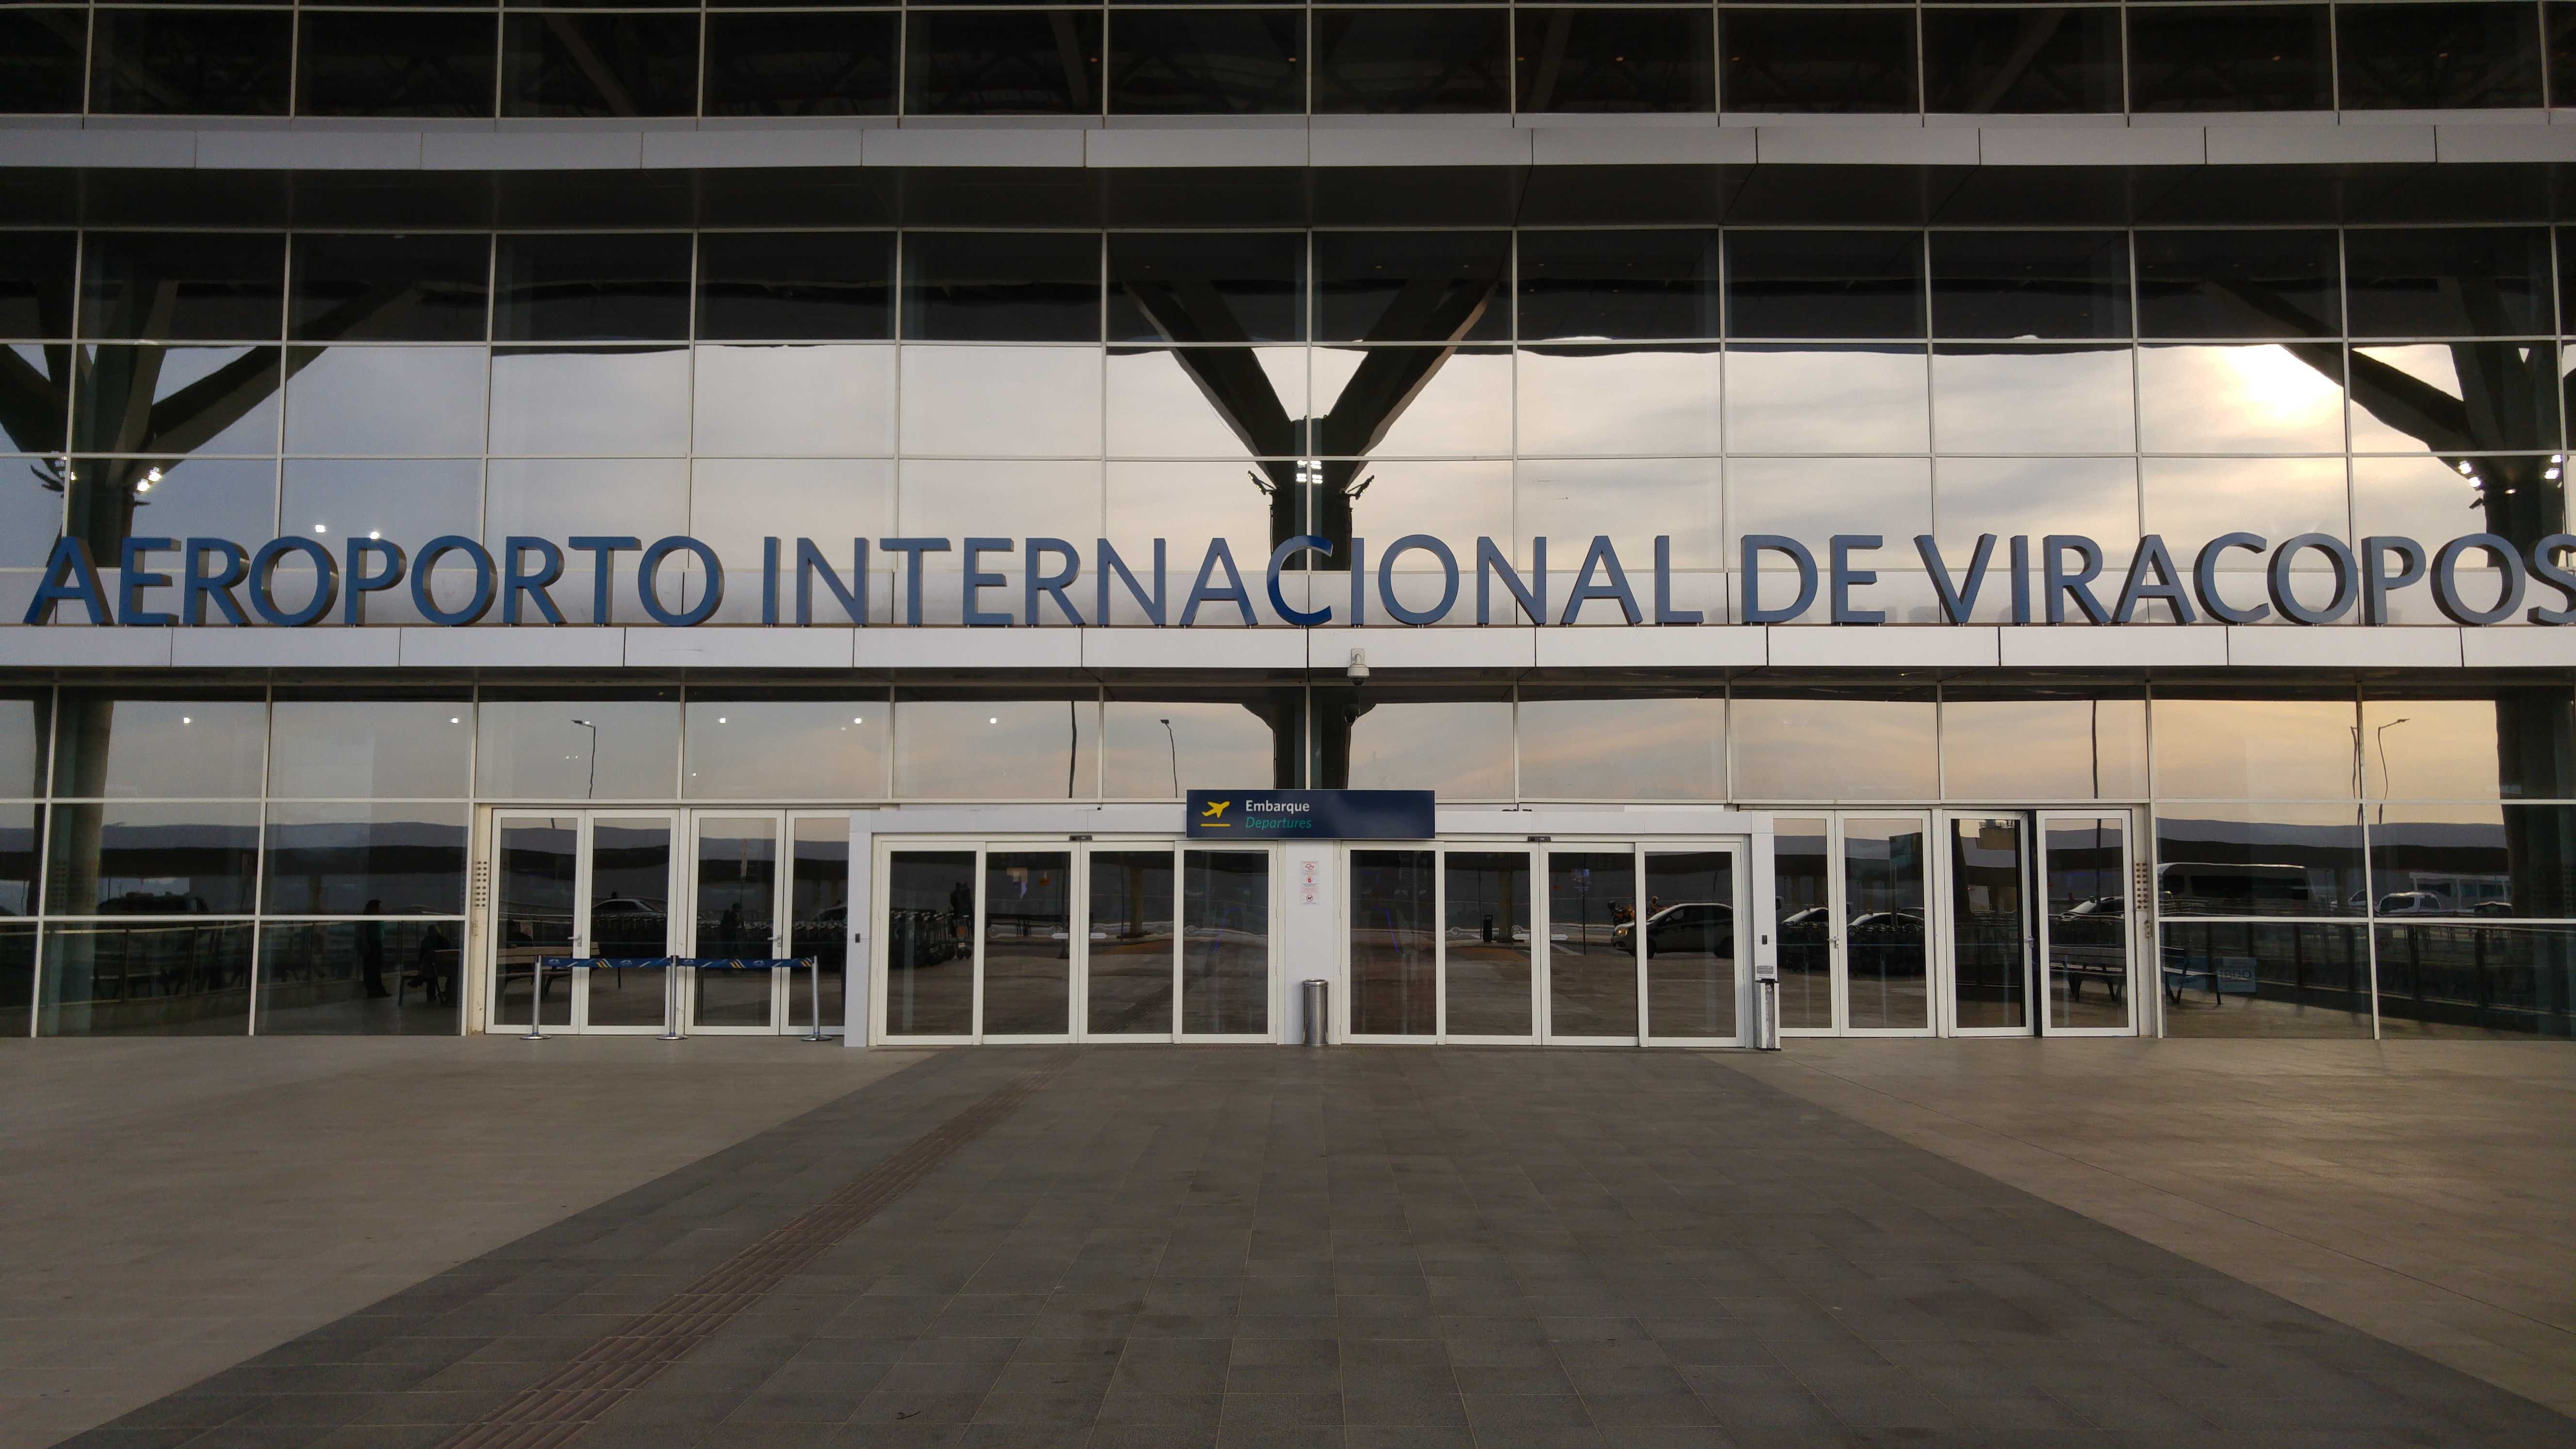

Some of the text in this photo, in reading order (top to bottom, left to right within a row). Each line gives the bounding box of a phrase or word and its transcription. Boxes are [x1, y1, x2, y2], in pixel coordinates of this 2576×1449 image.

[22, 532, 2576, 626] AEROPORTO INTERNACIONAL DE VIRACOPOS
[1245, 800, 1310, 815] Embarque
[1245, 817, 1312, 831] Departures
